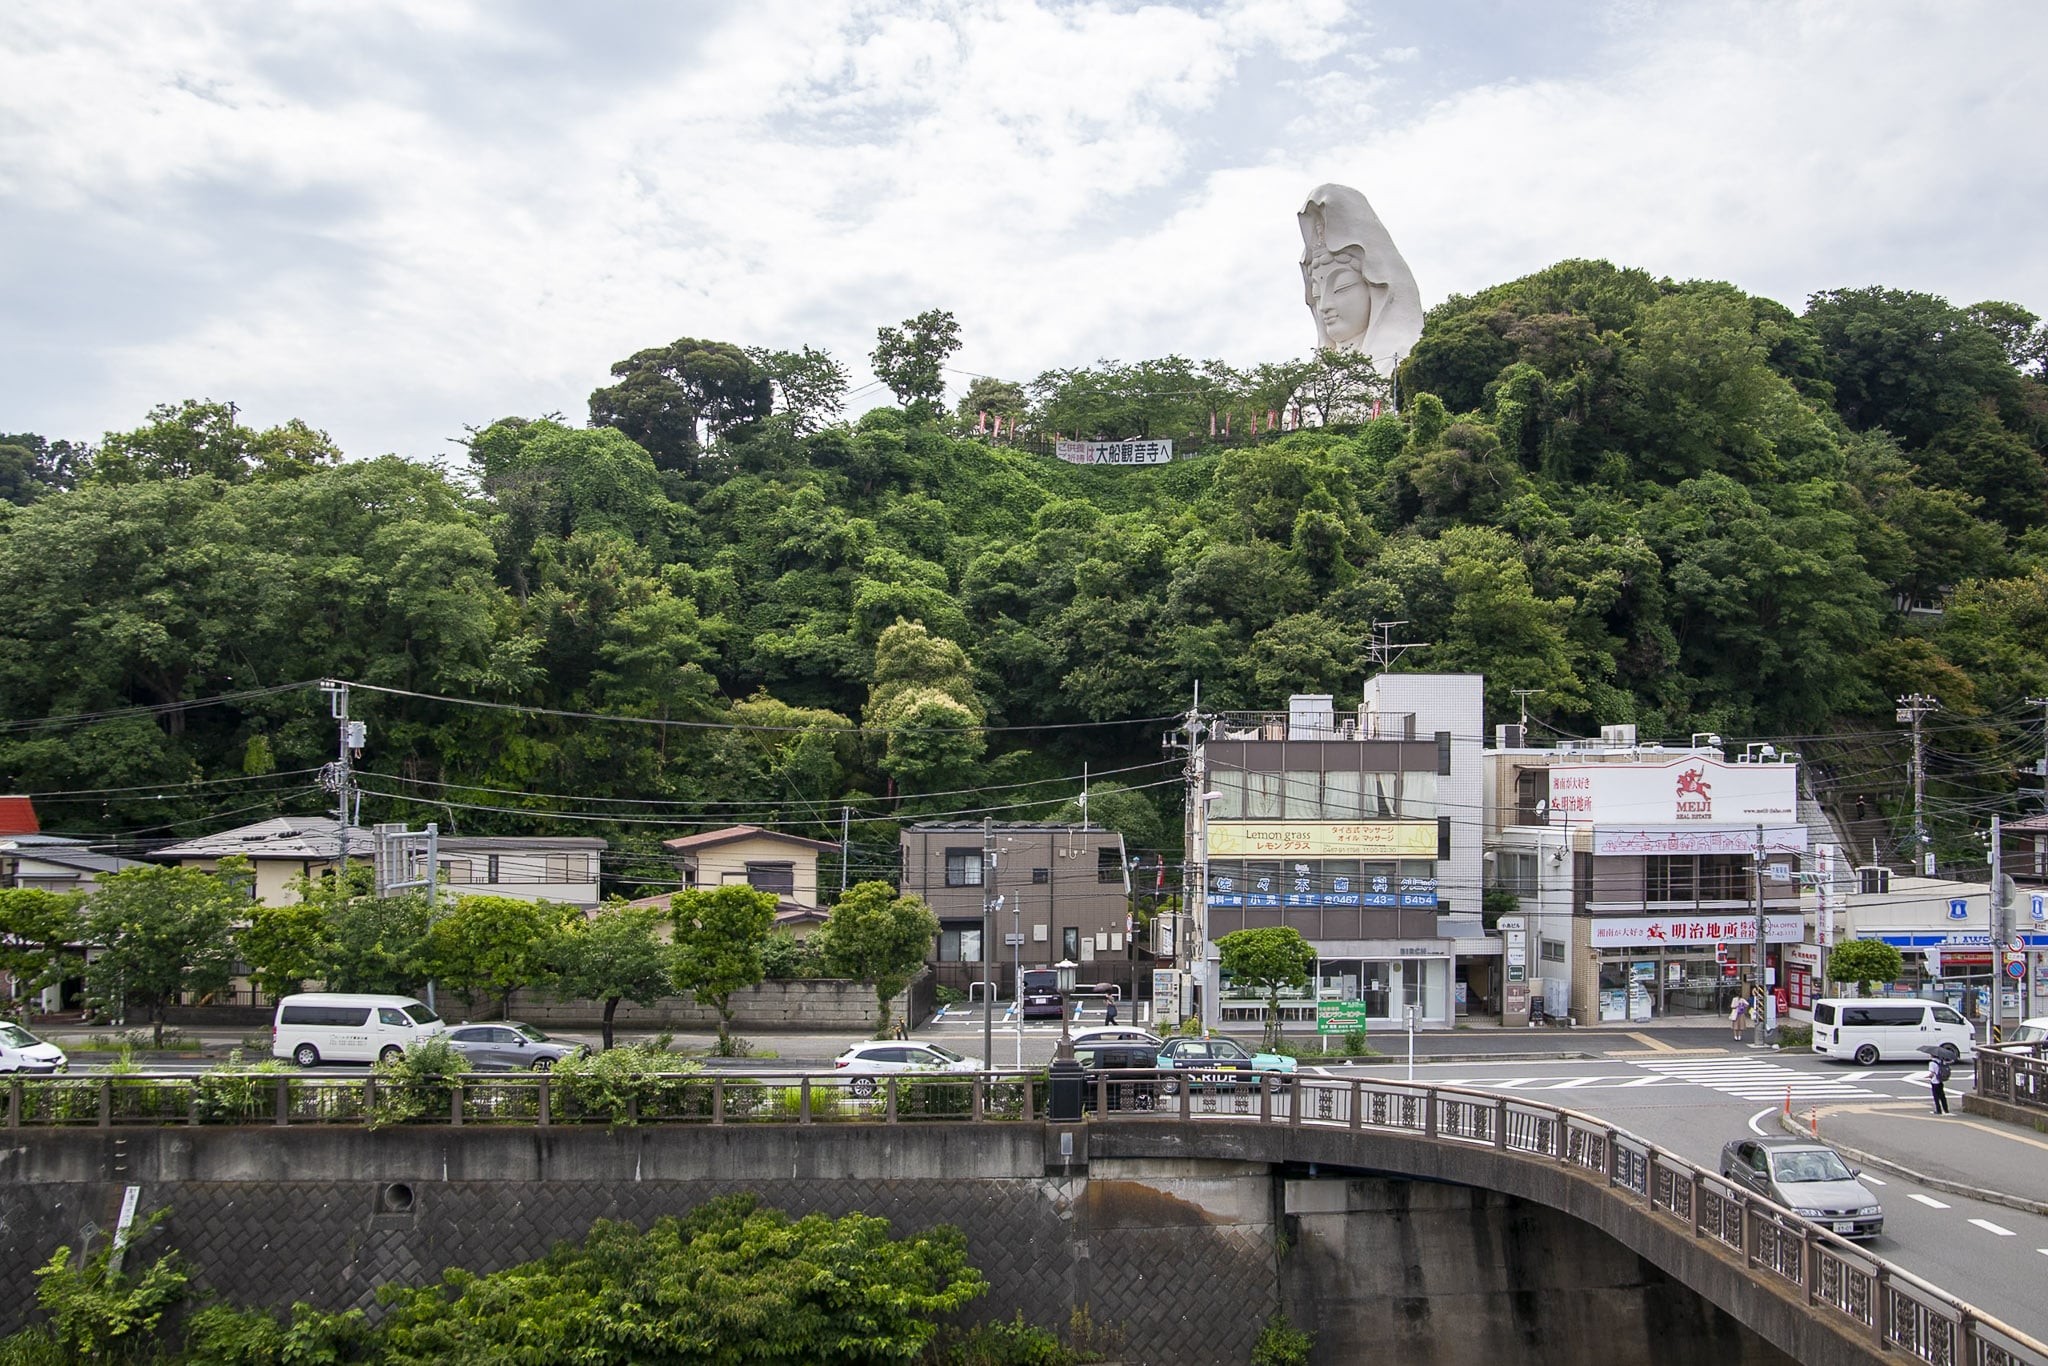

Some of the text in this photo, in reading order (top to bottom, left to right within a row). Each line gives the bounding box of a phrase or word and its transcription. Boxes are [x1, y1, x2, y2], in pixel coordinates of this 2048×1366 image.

[1561, 796, 1592, 812] 明治地所
[1676, 801, 1711, 812] MEIJI
[1246, 829, 1311, 841] Lemon grass
[1331, 826, 1360, 834] タイ古式
[1256, 841, 1311, 850] レモン グラス
[1250, 894, 1276, 905] 小児
[1597, 922, 1739, 940] 湘南が大好き 明治地所
